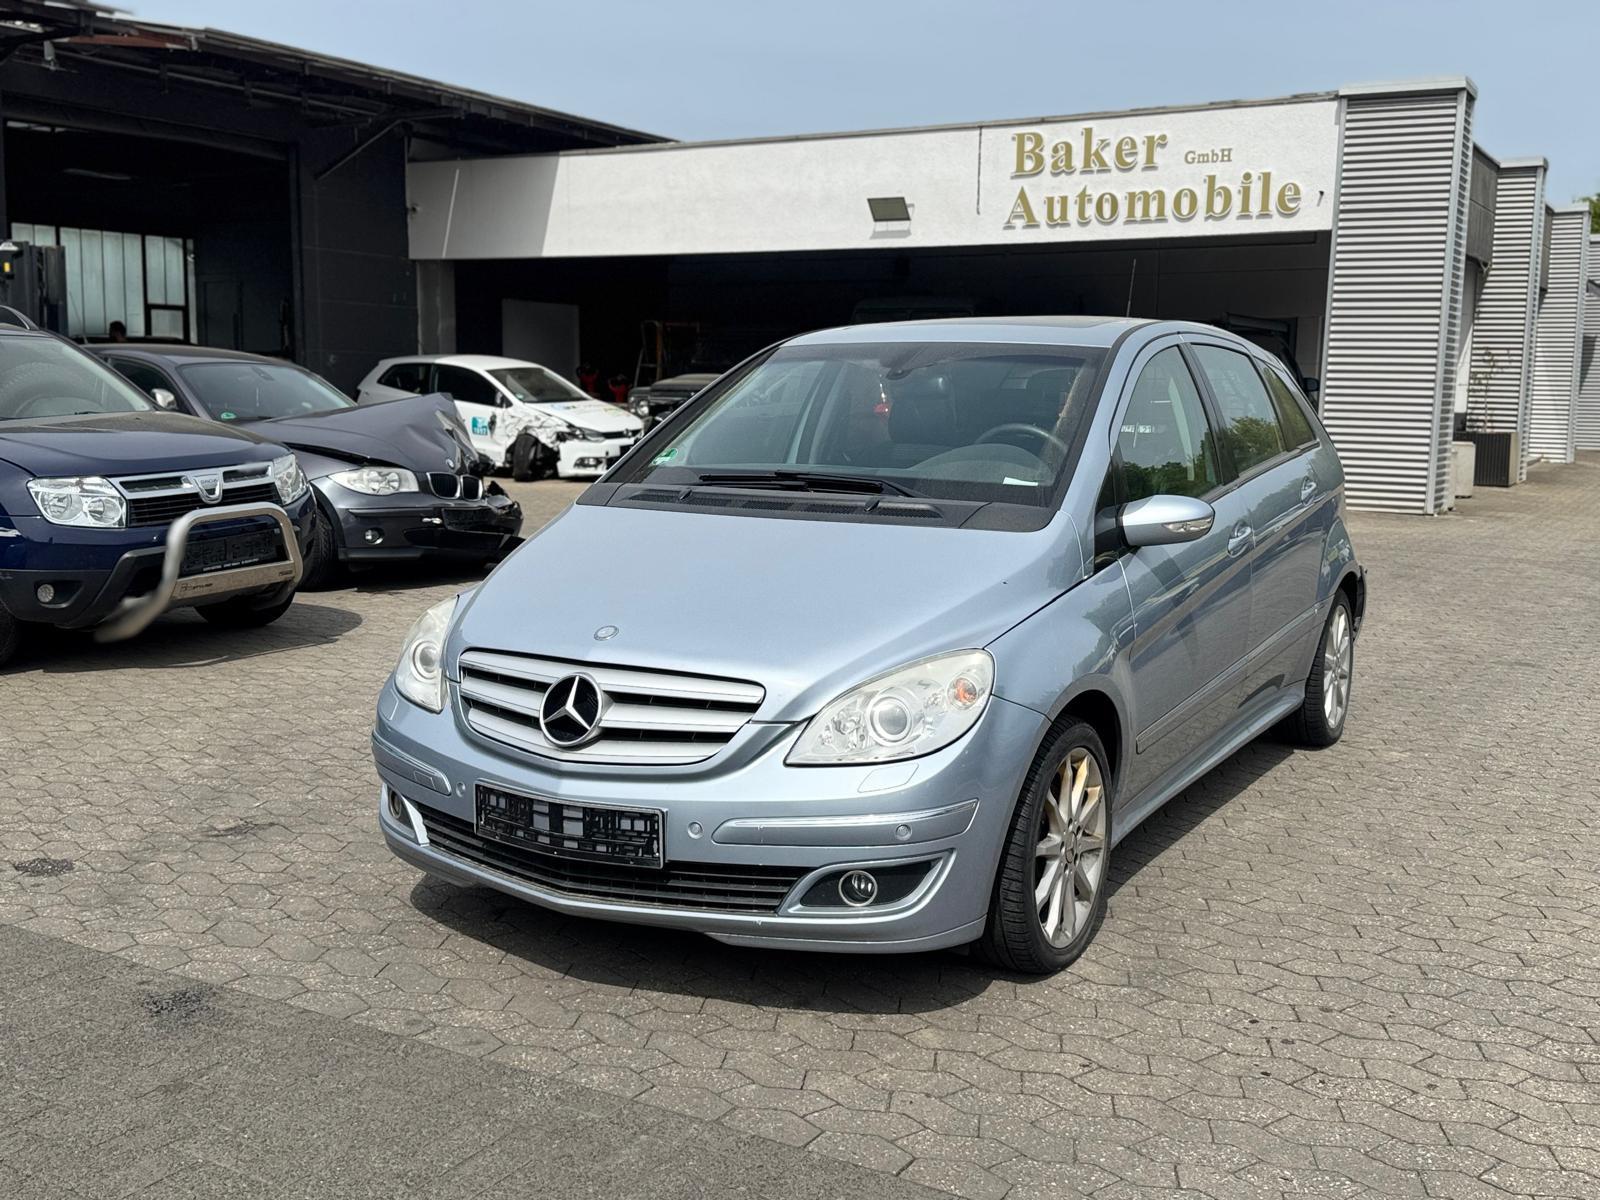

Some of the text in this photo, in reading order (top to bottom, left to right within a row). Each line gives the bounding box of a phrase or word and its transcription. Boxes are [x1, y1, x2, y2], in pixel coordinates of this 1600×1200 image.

[1012, 127, 1233, 177] Baker GmbH
[1004, 171, 1302, 228] Automobile
